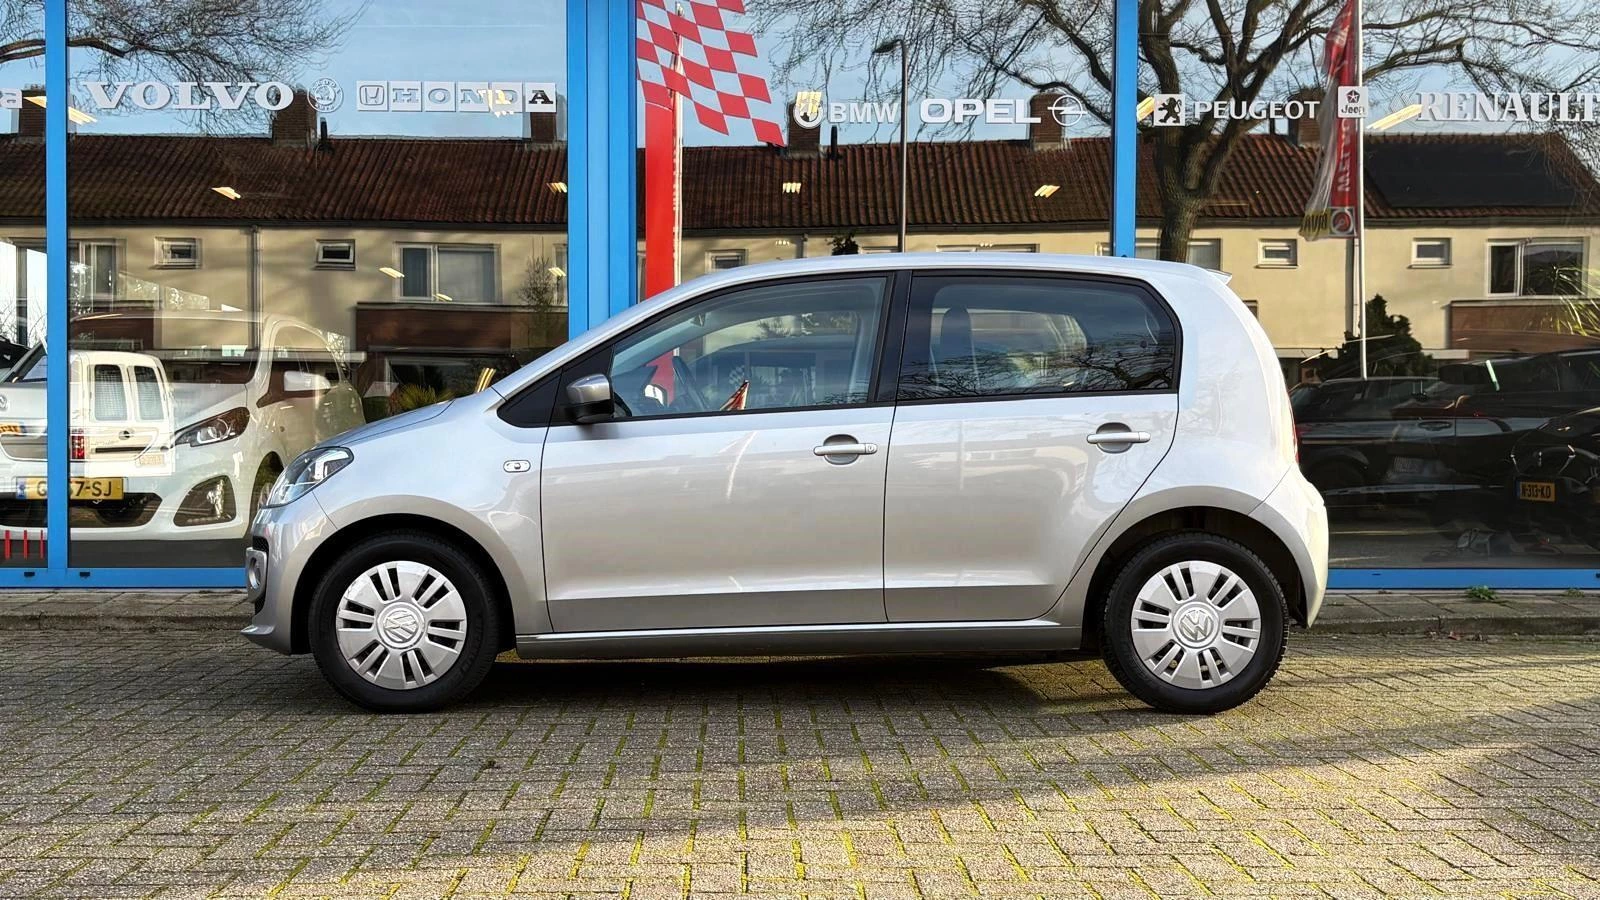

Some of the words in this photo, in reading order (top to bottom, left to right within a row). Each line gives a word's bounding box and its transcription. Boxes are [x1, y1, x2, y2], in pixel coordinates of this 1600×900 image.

[83, 81, 293, 110] VOLVO
[392, 88, 554, 105] HONDA
[1416, 91, 1600, 122] RENAULT
[829, 102, 899, 124] BMW
[920, 98, 1041, 124] OPEL
[1194, 100, 1320, 120] PEUGEOT
